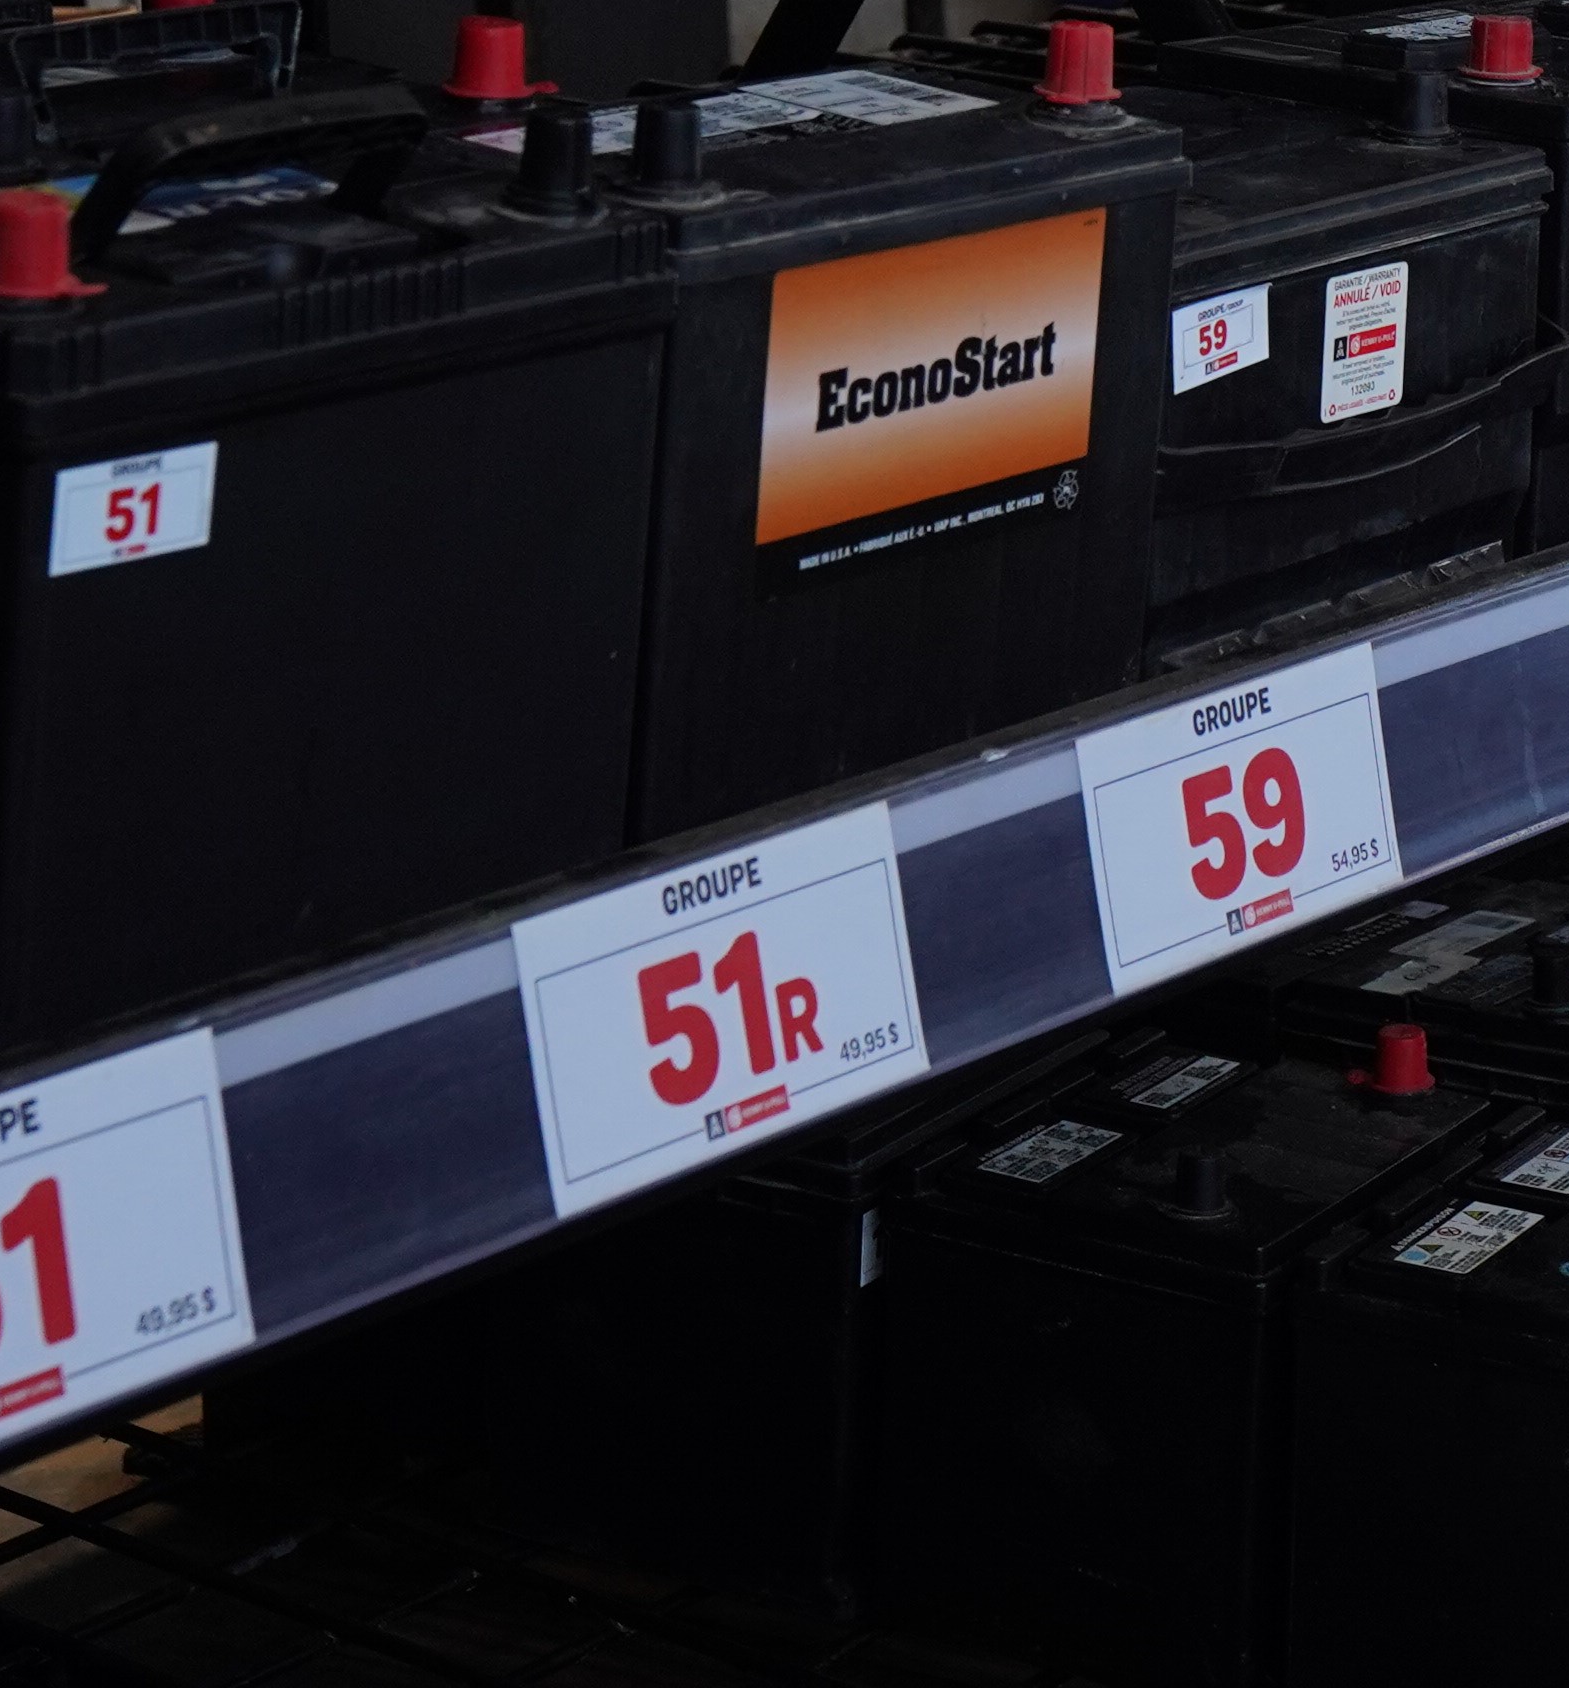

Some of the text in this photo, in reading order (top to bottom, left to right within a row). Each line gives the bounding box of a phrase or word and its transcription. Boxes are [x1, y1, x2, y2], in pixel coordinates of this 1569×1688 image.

[1333, 280, 1401, 308] ANNULÉ VOID
[1199, 318, 1227, 356] 59
[816, 322, 1055, 433] EconoStart
[106, 482, 161, 542] 51
[1193, 687, 1271, 736] GROUPE
[1182, 747, 1305, 900] 59
[1331, 838, 1379, 872] 54,95 $
[662, 857, 762, 915] GROUPE
[637, 930, 824, 1106] 51R
[839, 1022, 899, 1063] 49,95 $
